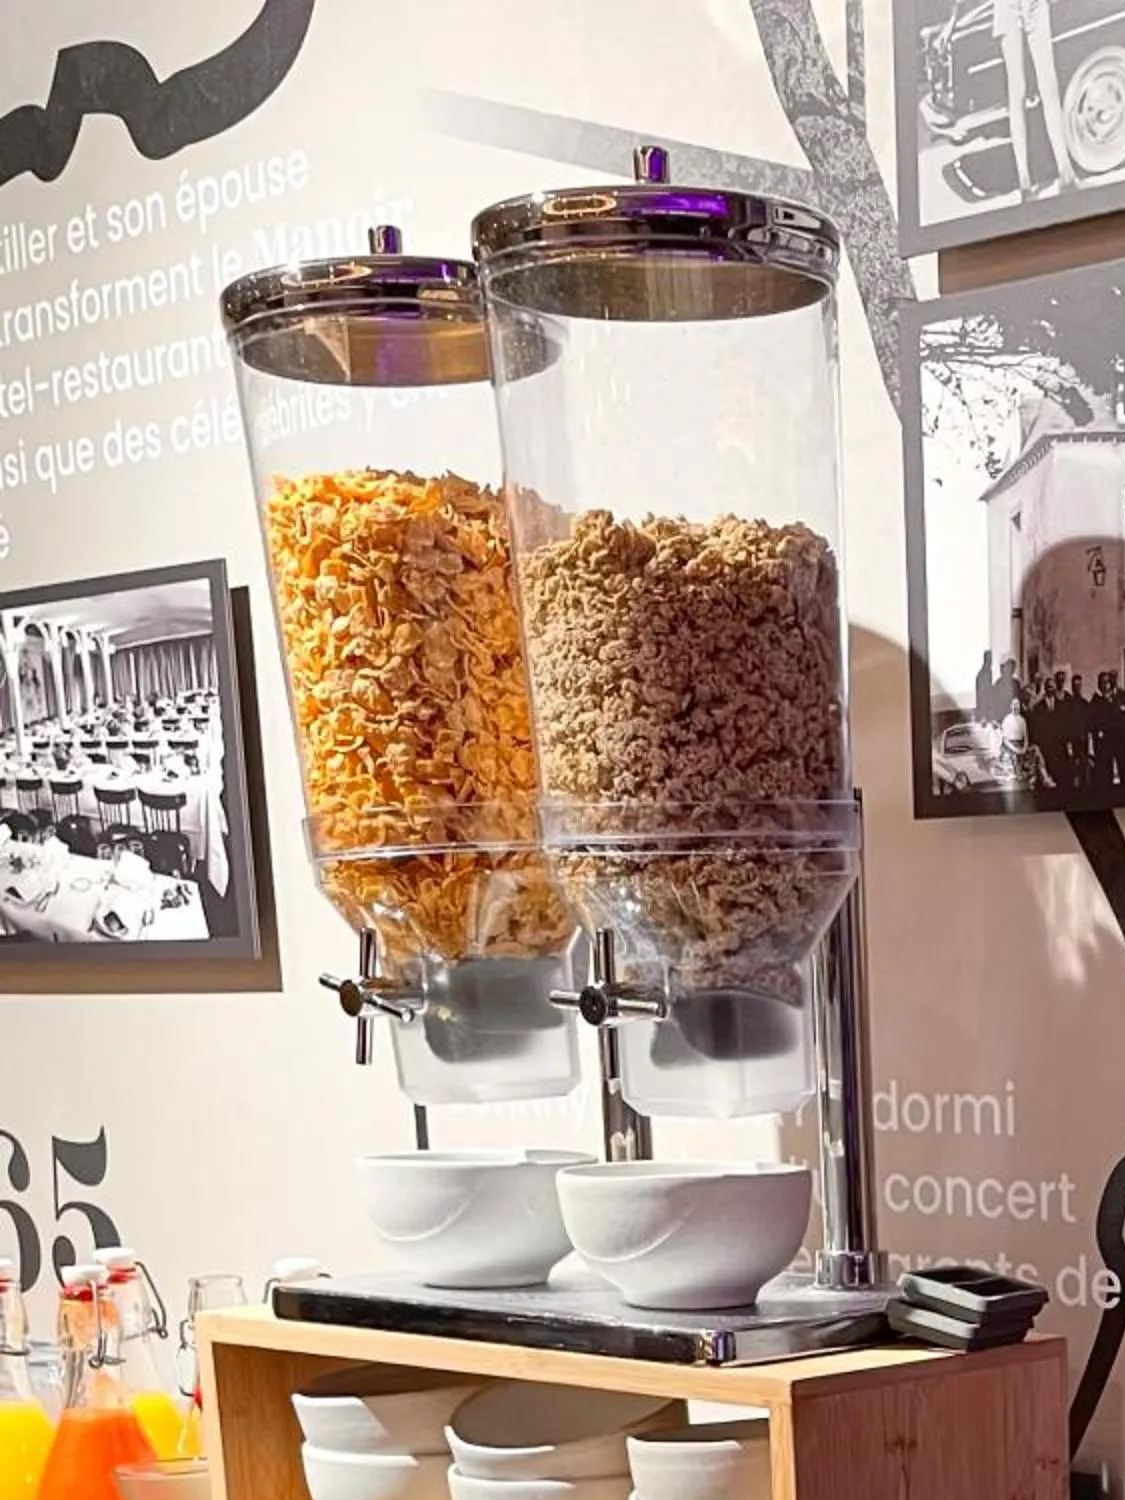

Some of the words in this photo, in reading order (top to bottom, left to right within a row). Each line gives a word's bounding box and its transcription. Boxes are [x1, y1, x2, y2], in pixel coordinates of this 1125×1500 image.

[0, 221, 57, 275] iller
[67, 205, 99, 254] et
[106, 189, 167, 243] son
[175, 149, 311, 234] épouse
[0, 251, 203, 347] ransforment
[211, 243, 244, 292] le
[0, 438, 28, 489] si
[34, 435, 95, 494] que
[103, 418, 162, 467] des
[872, 1079, 1016, 1137] dormi
[884, 1172, 1077, 1223] concert
[1056, 1254, 1123, 1310] de
